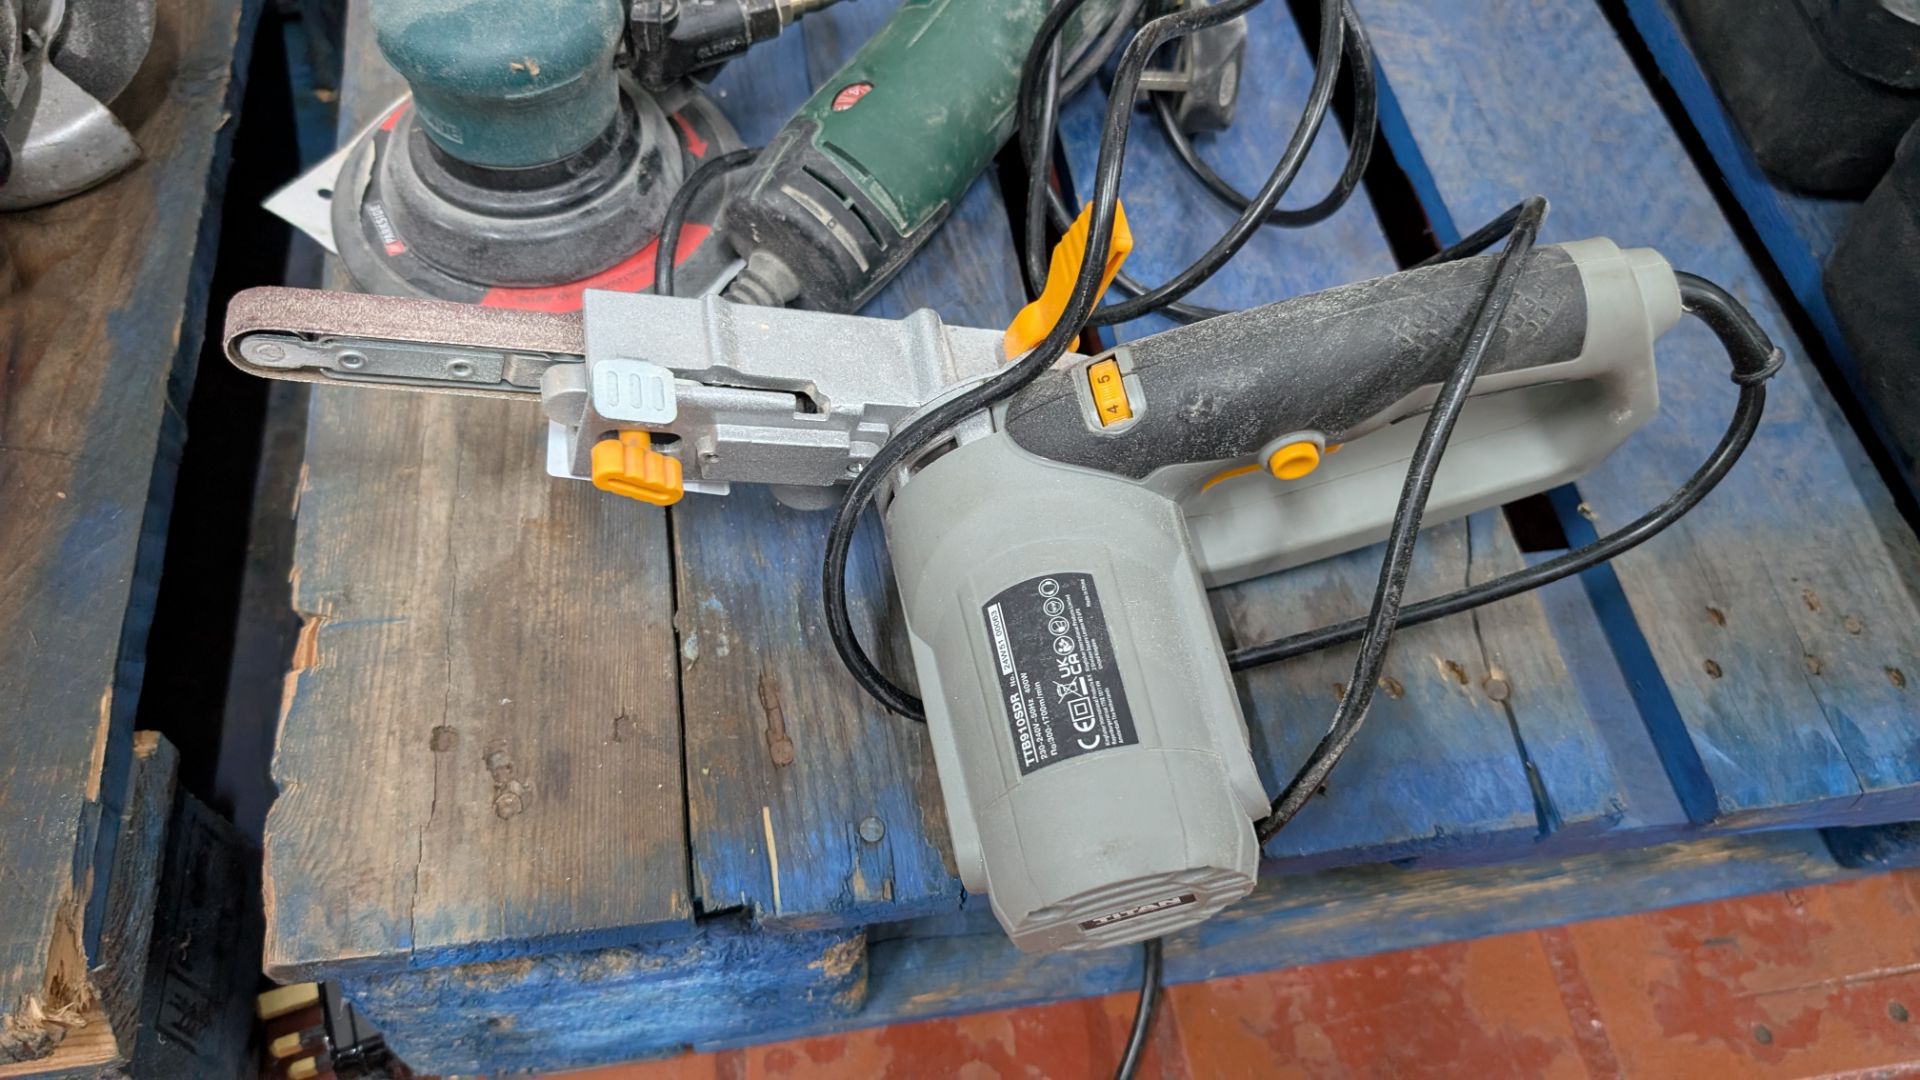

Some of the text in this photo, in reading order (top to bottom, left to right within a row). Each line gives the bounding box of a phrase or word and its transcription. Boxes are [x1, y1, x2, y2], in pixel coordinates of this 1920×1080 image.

[1097, 375, 1119, 414] 4 5
[997, 639, 1011, 670] 24W51
[1057, 656, 1070, 678] UK
[1067, 653, 1082, 675] CA
[1007, 673, 1016, 686] No.
[1019, 671, 1031, 693] 400W
[1009, 692, 1036, 766] TTB910SDR
[1093, 896, 1182, 925] TITAN
